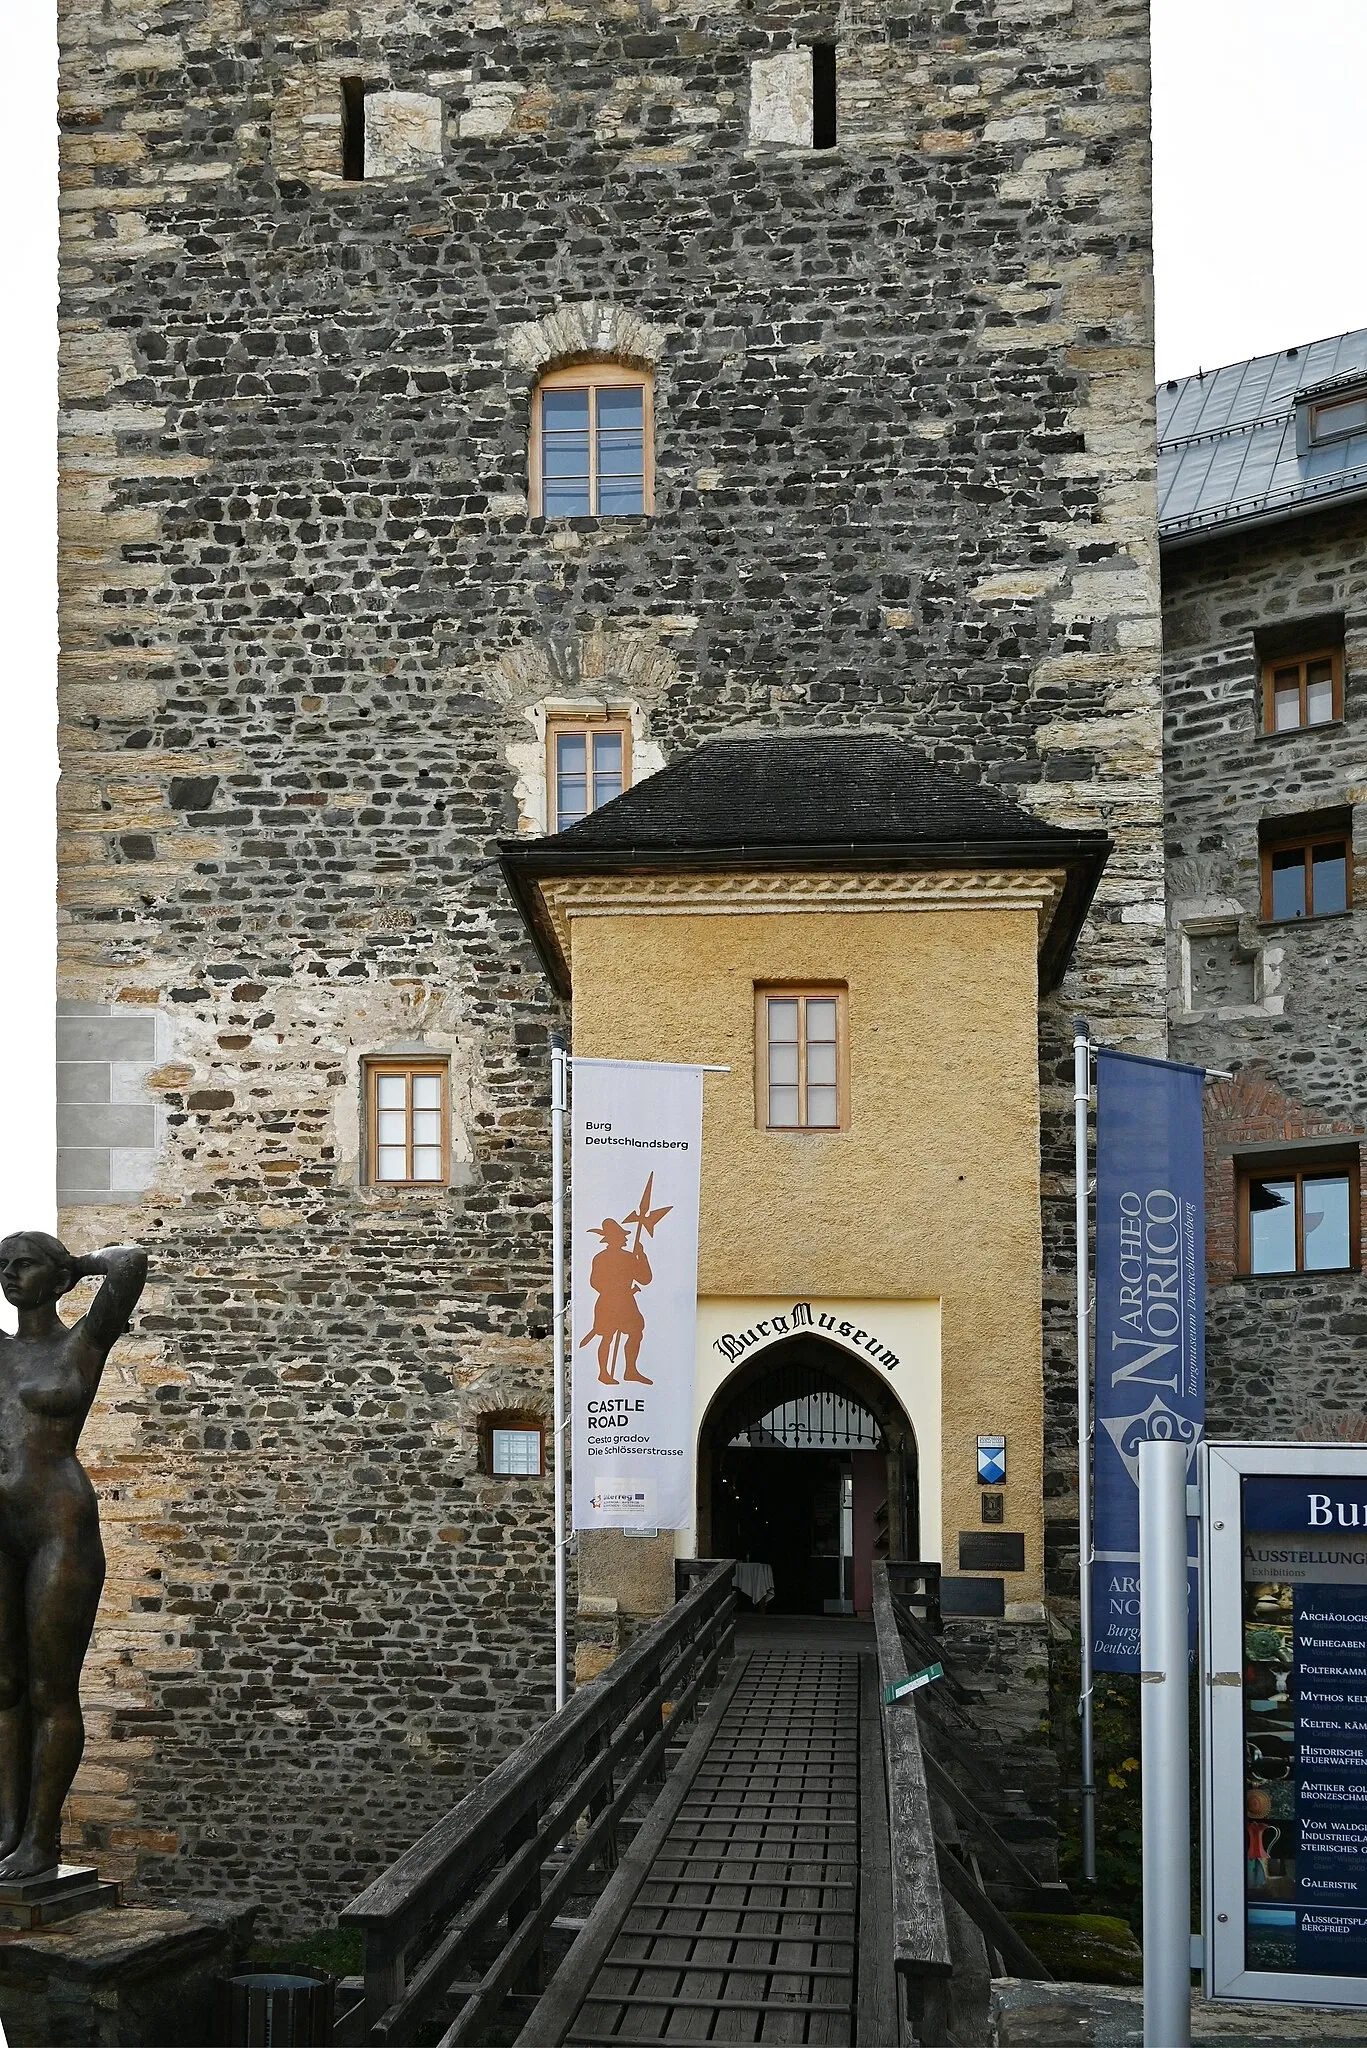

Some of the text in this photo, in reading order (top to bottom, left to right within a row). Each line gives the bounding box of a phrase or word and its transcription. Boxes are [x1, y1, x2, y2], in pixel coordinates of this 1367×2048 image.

[585, 1121, 612, 1132] Burg
[585, 1136, 689, 1150] Deutschlandsberg
[1119, 1191, 1144, 1333] ARCHEO
[1111, 1189, 1180, 1394] NORICO
[1186, 1201, 1200, 1397] Burgmuseum Deutschlandsberg
[587, 1399, 645, 1413] CASTLE
[588, 1415, 629, 1429] ROAD
[587, 1434, 650, 1444] Cesta gradov
[588, 1446, 684, 1456] Die Schlösserstrasse
[1245, 1545, 1367, 1565] AUSSTELLUNG
[1252, 1567, 1306, 1578] Exhibitions
[1109, 1599, 1141, 1615] NO
[1107, 1623, 1141, 1641] Burg
[1299, 1636, 1366, 1648] WEIHEGABEN
[1300, 1691, 1344, 1702] MYTHOS
[1300, 1745, 1364, 1757] HISTORISCHE
[1300, 1756, 1367, 1766] FEUERWAFFEN
[1301, 1781, 1345, 1792] ANTIKER
[1301, 1819, 1327, 1830] VOM
[1301, 1843, 1358, 1853] STEIRISCHES
[1301, 1877, 1358, 1890] GALERISTIK
[1302, 1924, 1350, 1934] BERGFRIED
